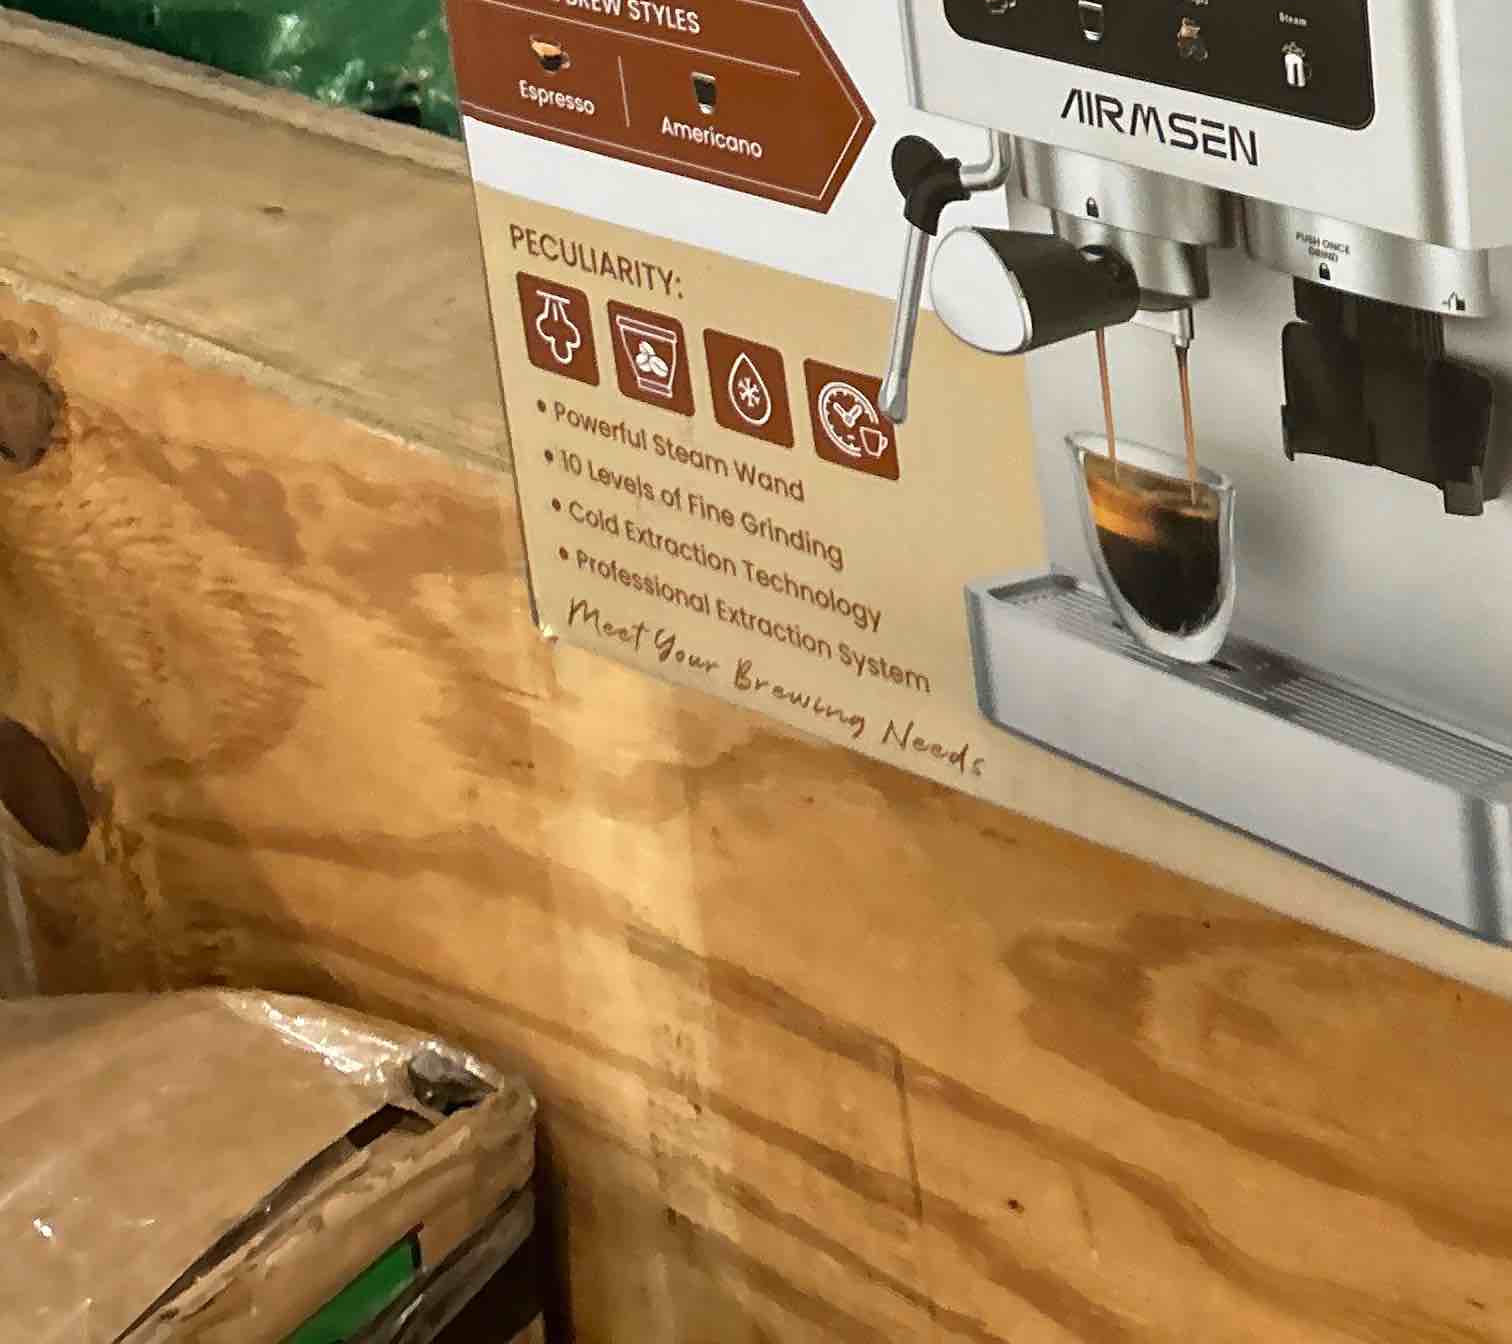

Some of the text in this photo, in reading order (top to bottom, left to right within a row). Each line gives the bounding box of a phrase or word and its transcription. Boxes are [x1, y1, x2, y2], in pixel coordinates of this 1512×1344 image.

[628, 0, 701, 34] STYLES
[519, 80, 595, 116] Espresso
[661, 116, 763, 159] Americano
[1060, 87, 1258, 167] AIRMSEN
[509, 223, 685, 300] PECULIARITY:
[554, 402, 805, 503] Powerful Steam Wand
[560, 450, 845, 572] 10 Levels of Fine Grinding
[569, 500, 882, 633] Cold Extraction Technology
[576, 548, 932, 694] Professional Extraction System
[567, 596, 986, 777] Meet Your Brewing Needs
